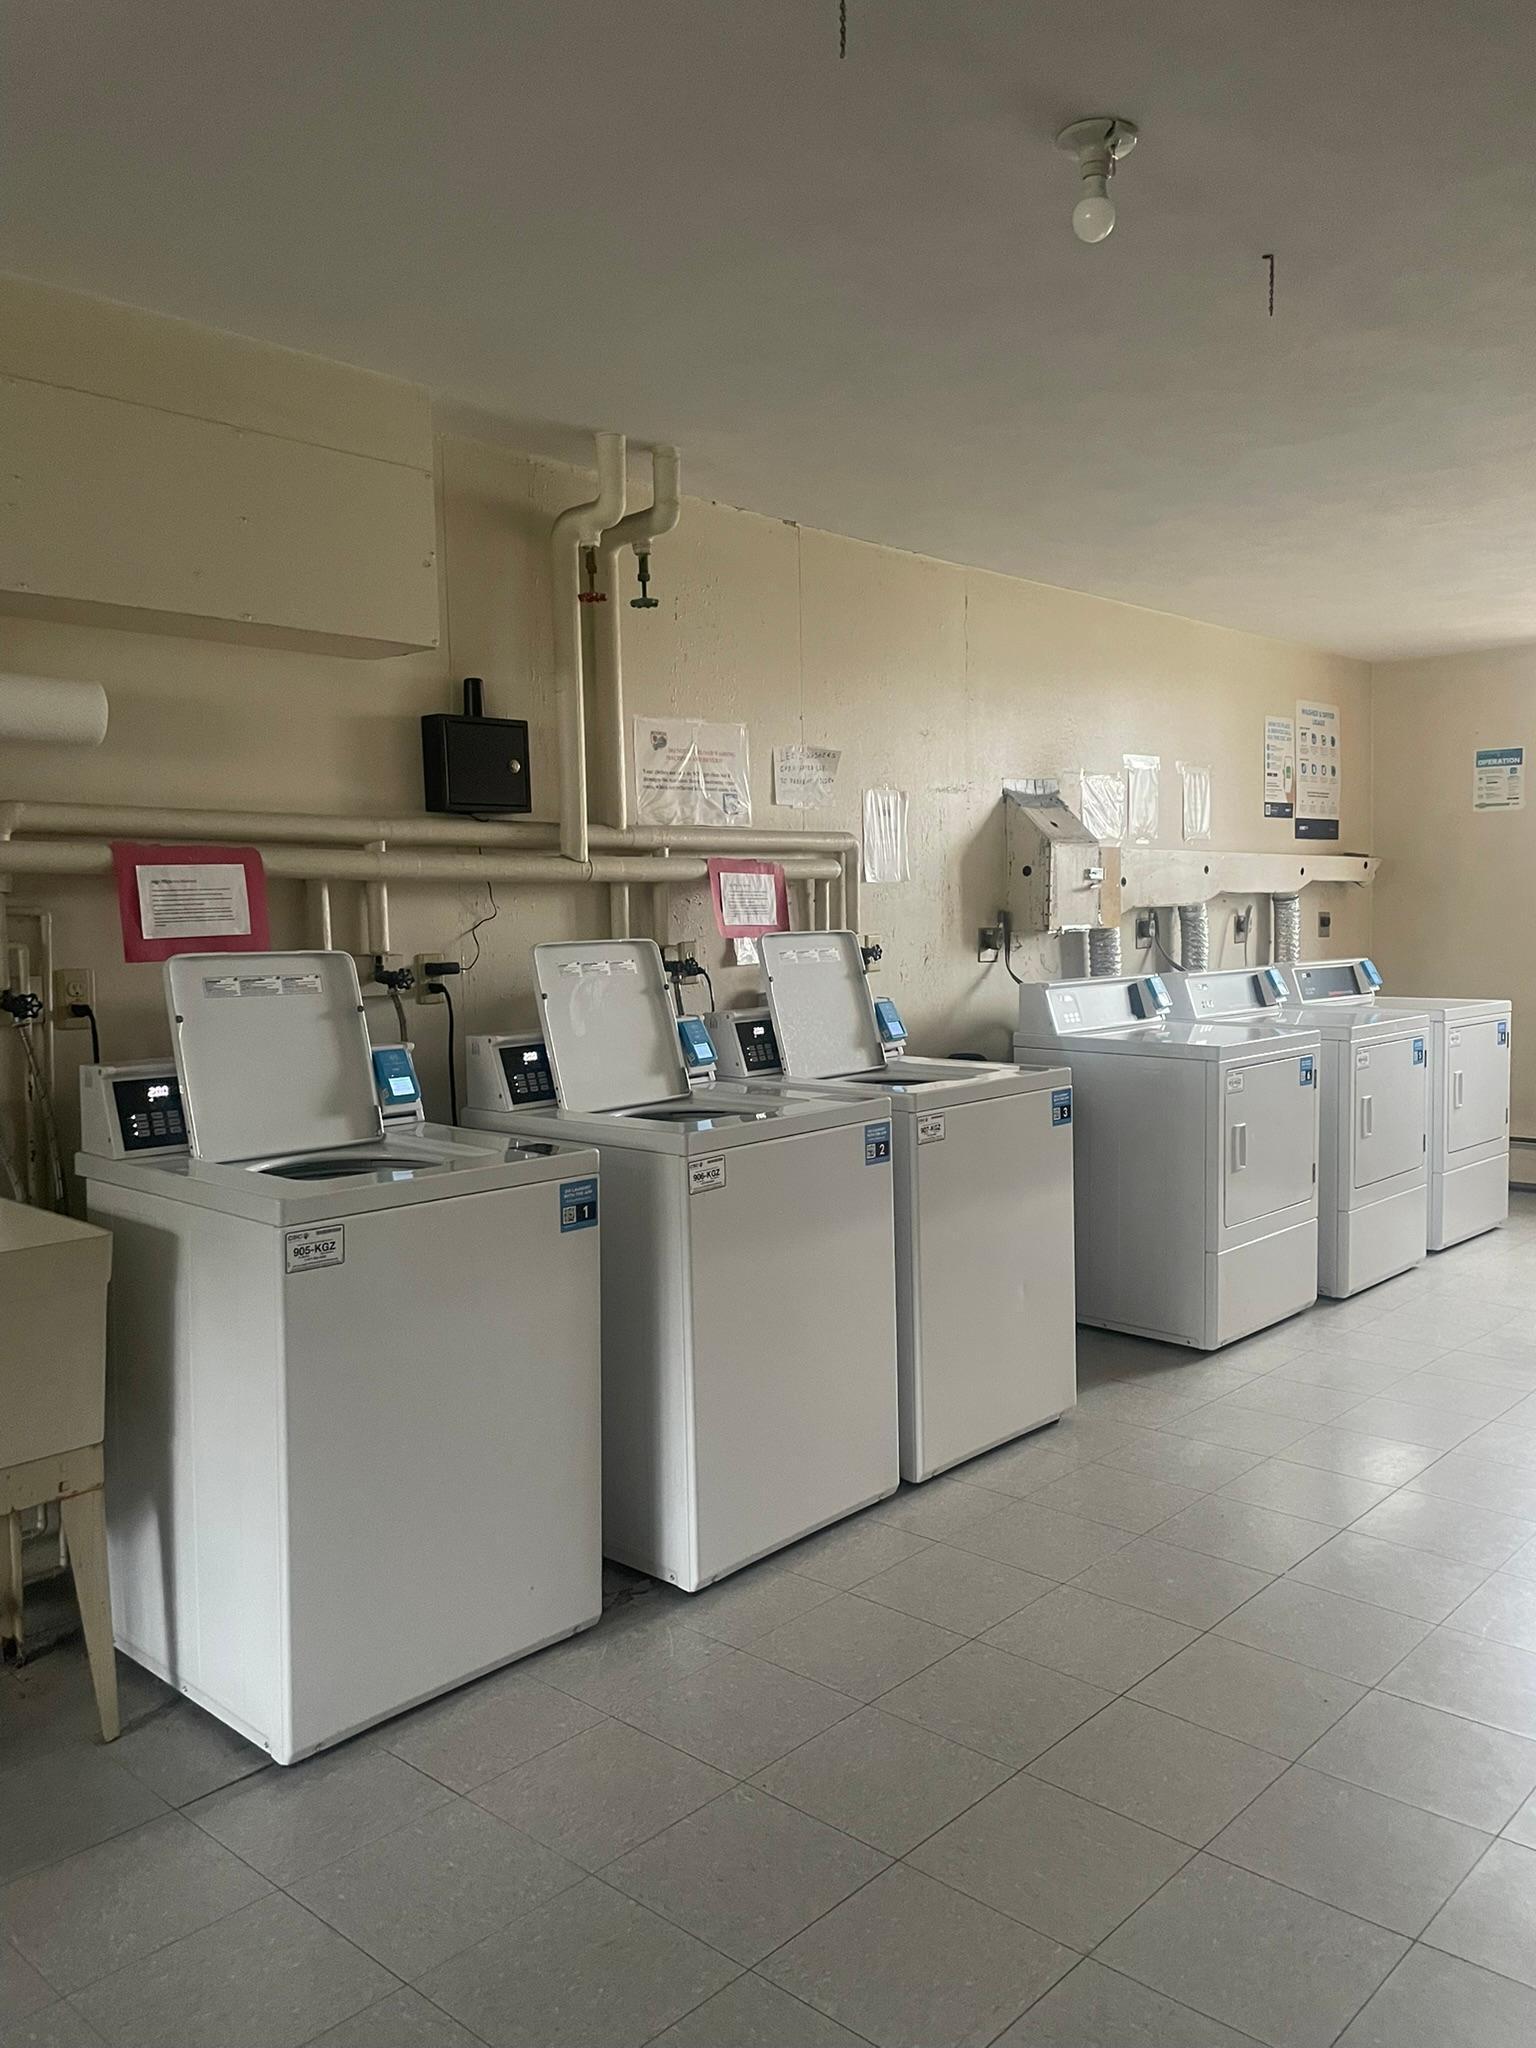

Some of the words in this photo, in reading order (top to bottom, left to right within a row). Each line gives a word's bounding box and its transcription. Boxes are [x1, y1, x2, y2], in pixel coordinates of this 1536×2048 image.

[1477, 757, 1520, 766] OPERATION
[1062, 1106, 1068, 1118] 3
[879, 1143, 885, 1155] 2
[582, 1205, 589, 1219] 1
[293, 1240, 336, 1257] 905-KGZ
